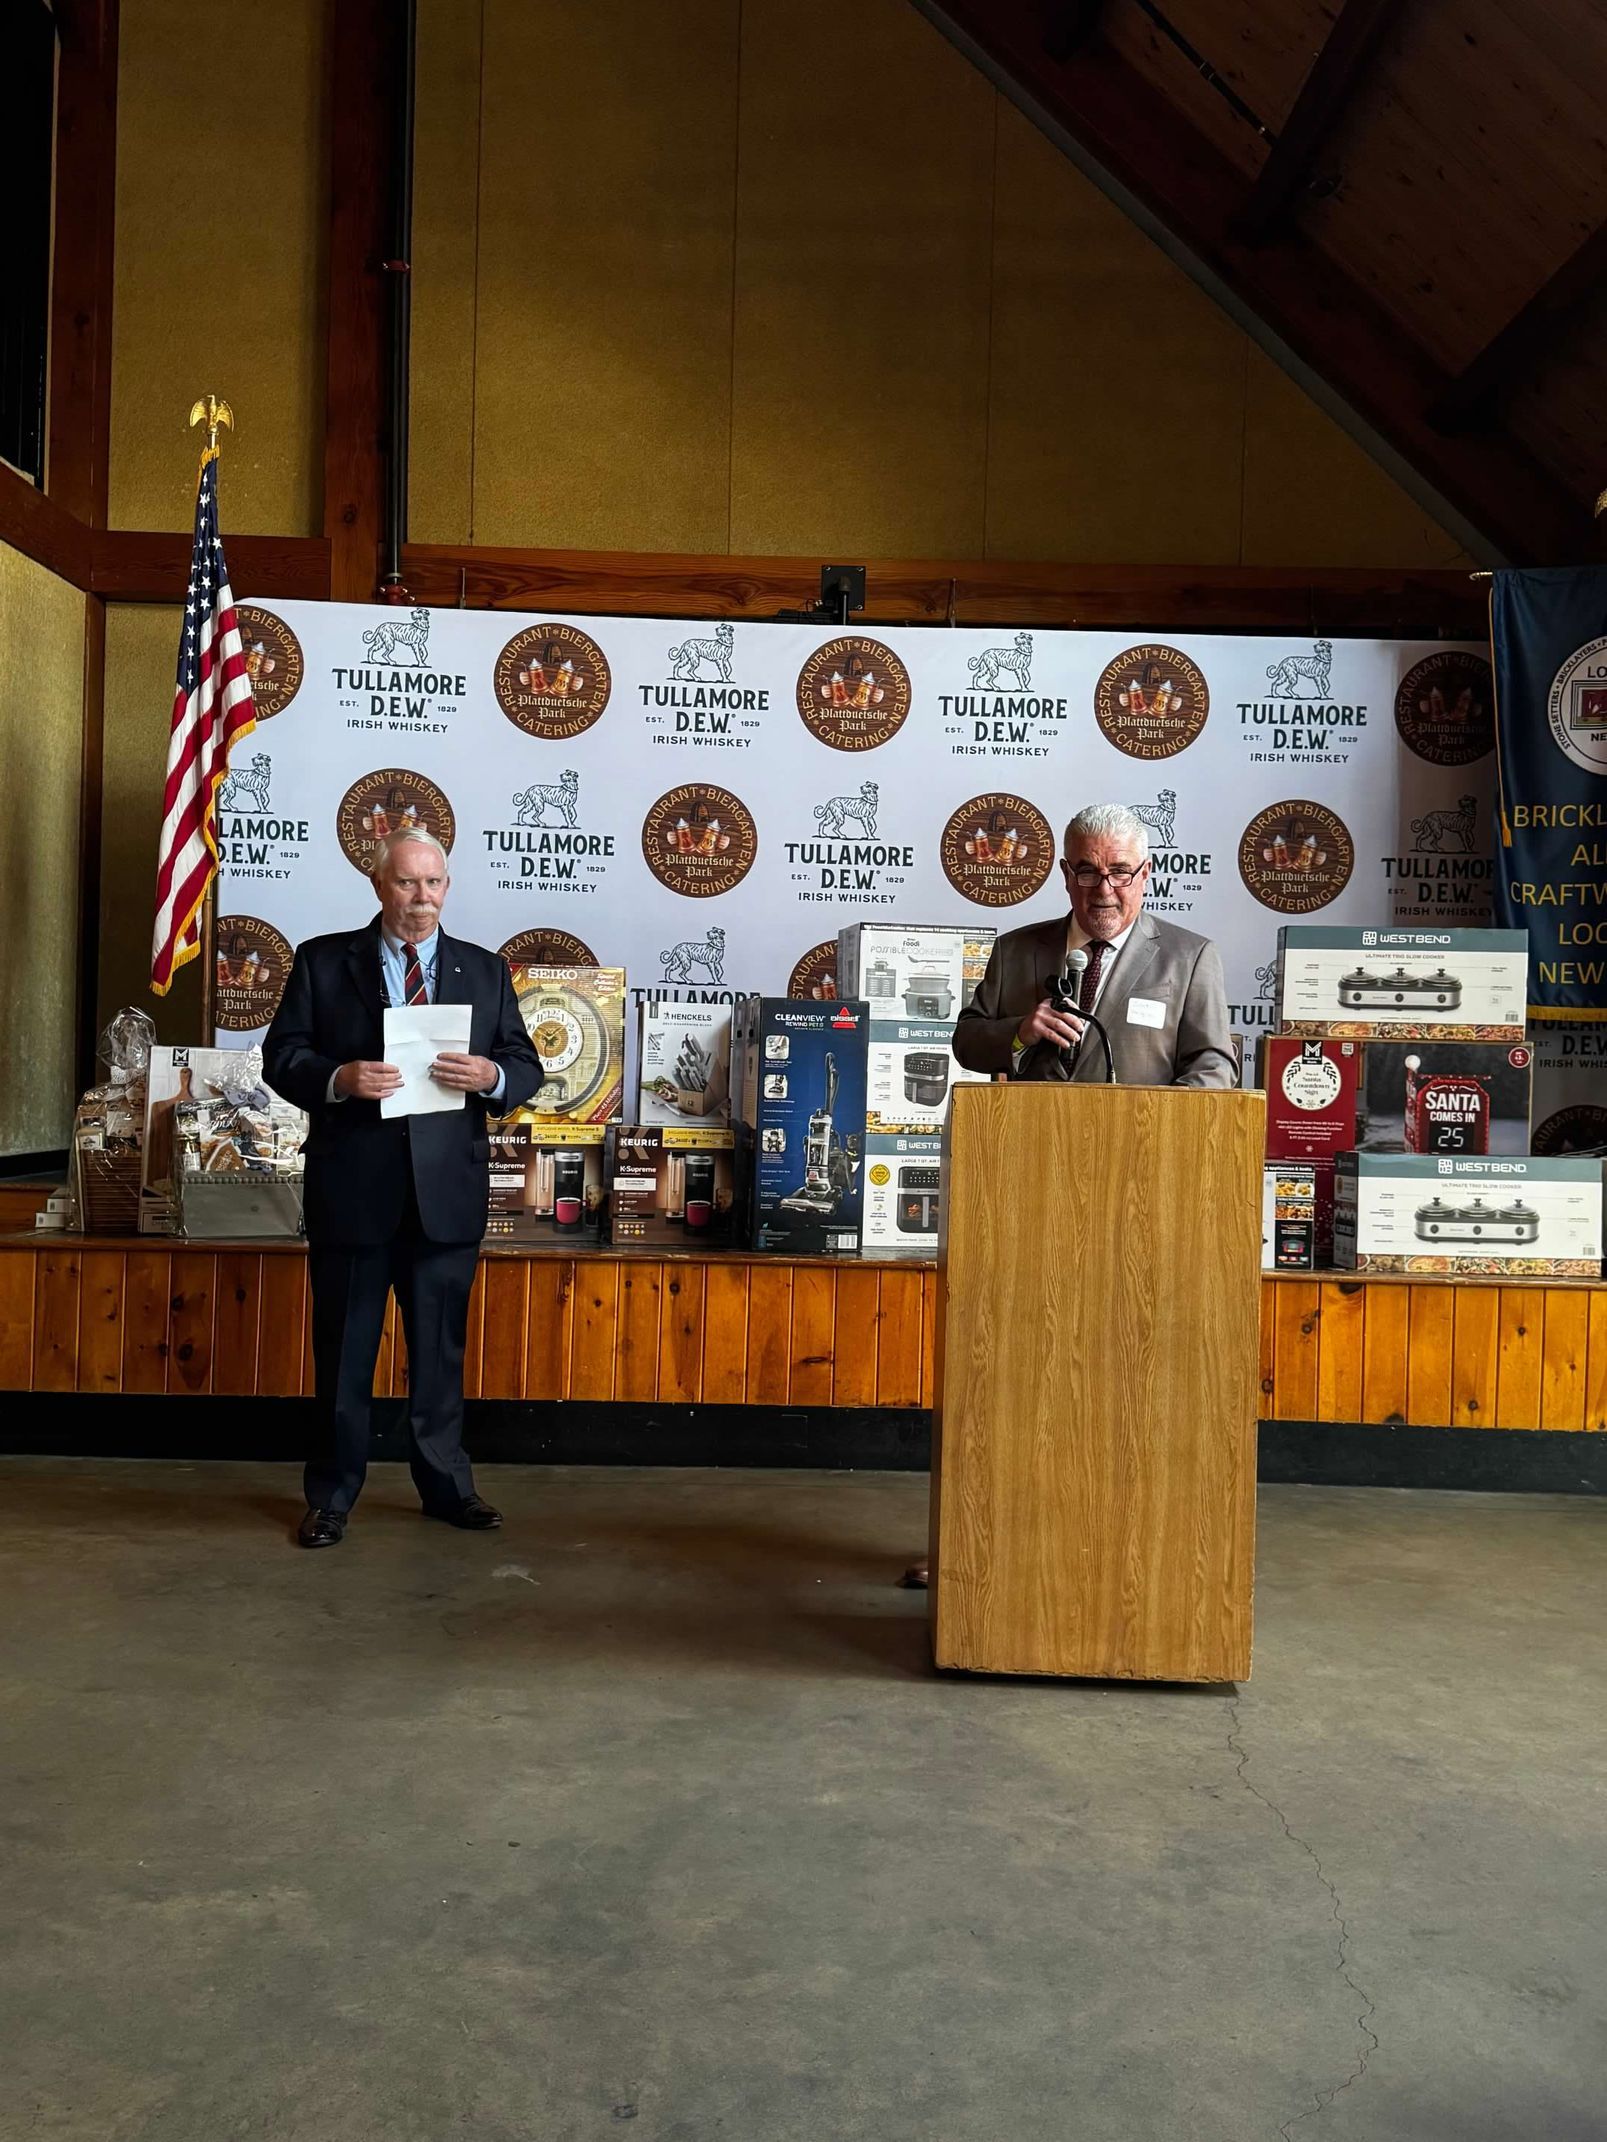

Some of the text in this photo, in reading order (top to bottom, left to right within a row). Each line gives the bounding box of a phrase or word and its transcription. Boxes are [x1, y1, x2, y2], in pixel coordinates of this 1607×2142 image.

[251, 610, 300, 695] BIERGARTEN
[499, 627, 607, 712] RESTAURANT BIERGARTEN
[332, 668, 466, 696] TULLAMORE
[801, 640, 907, 723] RESTAURANT BIERGARTEN
[1100, 648, 1205, 731] RESTAURANT BIERGARTEN
[1551, 691, 1560, 724] SETTERS
[1558, 643, 1597, 685] BRICKLAYERS
[639, 685, 769, 710] TULLAMORE
[938, 696, 1067, 719] TULLAMORE
[538, 708, 565, 718] Park
[1236, 704, 1367, 726] TULLAMORE
[348, 720, 448, 733] IRISH WHISKEY
[517, 712, 588, 735] CATERING
[840, 720, 866, 731] Park
[1137, 728, 1164, 739] Park
[653, 736, 751, 747] IRISH WHISKEY
[819, 726, 888, 747] CATERING
[1117, 734, 1187, 756] CATERING
[952, 746, 1049, 756] IRISH WHISKEY
[1251, 753, 1349, 763] IRISH WHISKEY
[342, 772, 451, 852] RESTAURANT BIERGARTE
[1514, 804, 1607, 828] BRICKL
[219, 817, 309, 841] LAMORE
[647, 787, 752, 870] RESTAURANT BIERGARTEN
[946, 797, 1050, 879] RESTAURANT BIERGARTEN
[483, 831, 614, 856] TULLAMORE
[1244, 804, 1349, 886] RESTAURANT BIERGARTEN
[784, 844, 913, 866] TULLAMORE
[231, 868, 291, 879] WHISKEY
[686, 866, 713, 877] Park
[983, 876, 1010, 887] Park
[498, 881, 596, 892] IRISH WHISKEY
[664, 872, 735, 894] CATERING
[963, 882, 1032, 903] CATERING
[1282, 882, 1308, 893] Park
[799, 892, 895, 903] IRISH WHISKEY
[1261, 888, 1331, 910] CATERING
[1395, 907, 1430, 916] IRISH
[528, 968, 577, 980] SEIKO
[223, 1000, 252, 1011] Park
[671, 1013, 712, 1022] HENCKELS
[775, 1014, 824, 1022] CLEANVIEW
[1540, 1059, 1573, 1068] IRISH
[1425, 1091, 1480, 1111] SANTA
[1430, 1111, 1475, 1122] COMES IN
[488, 1136, 527, 1144] KEURIG
[620, 1138, 658, 1147] KEURIG
[1438, 1127, 1463, 1147] 25
